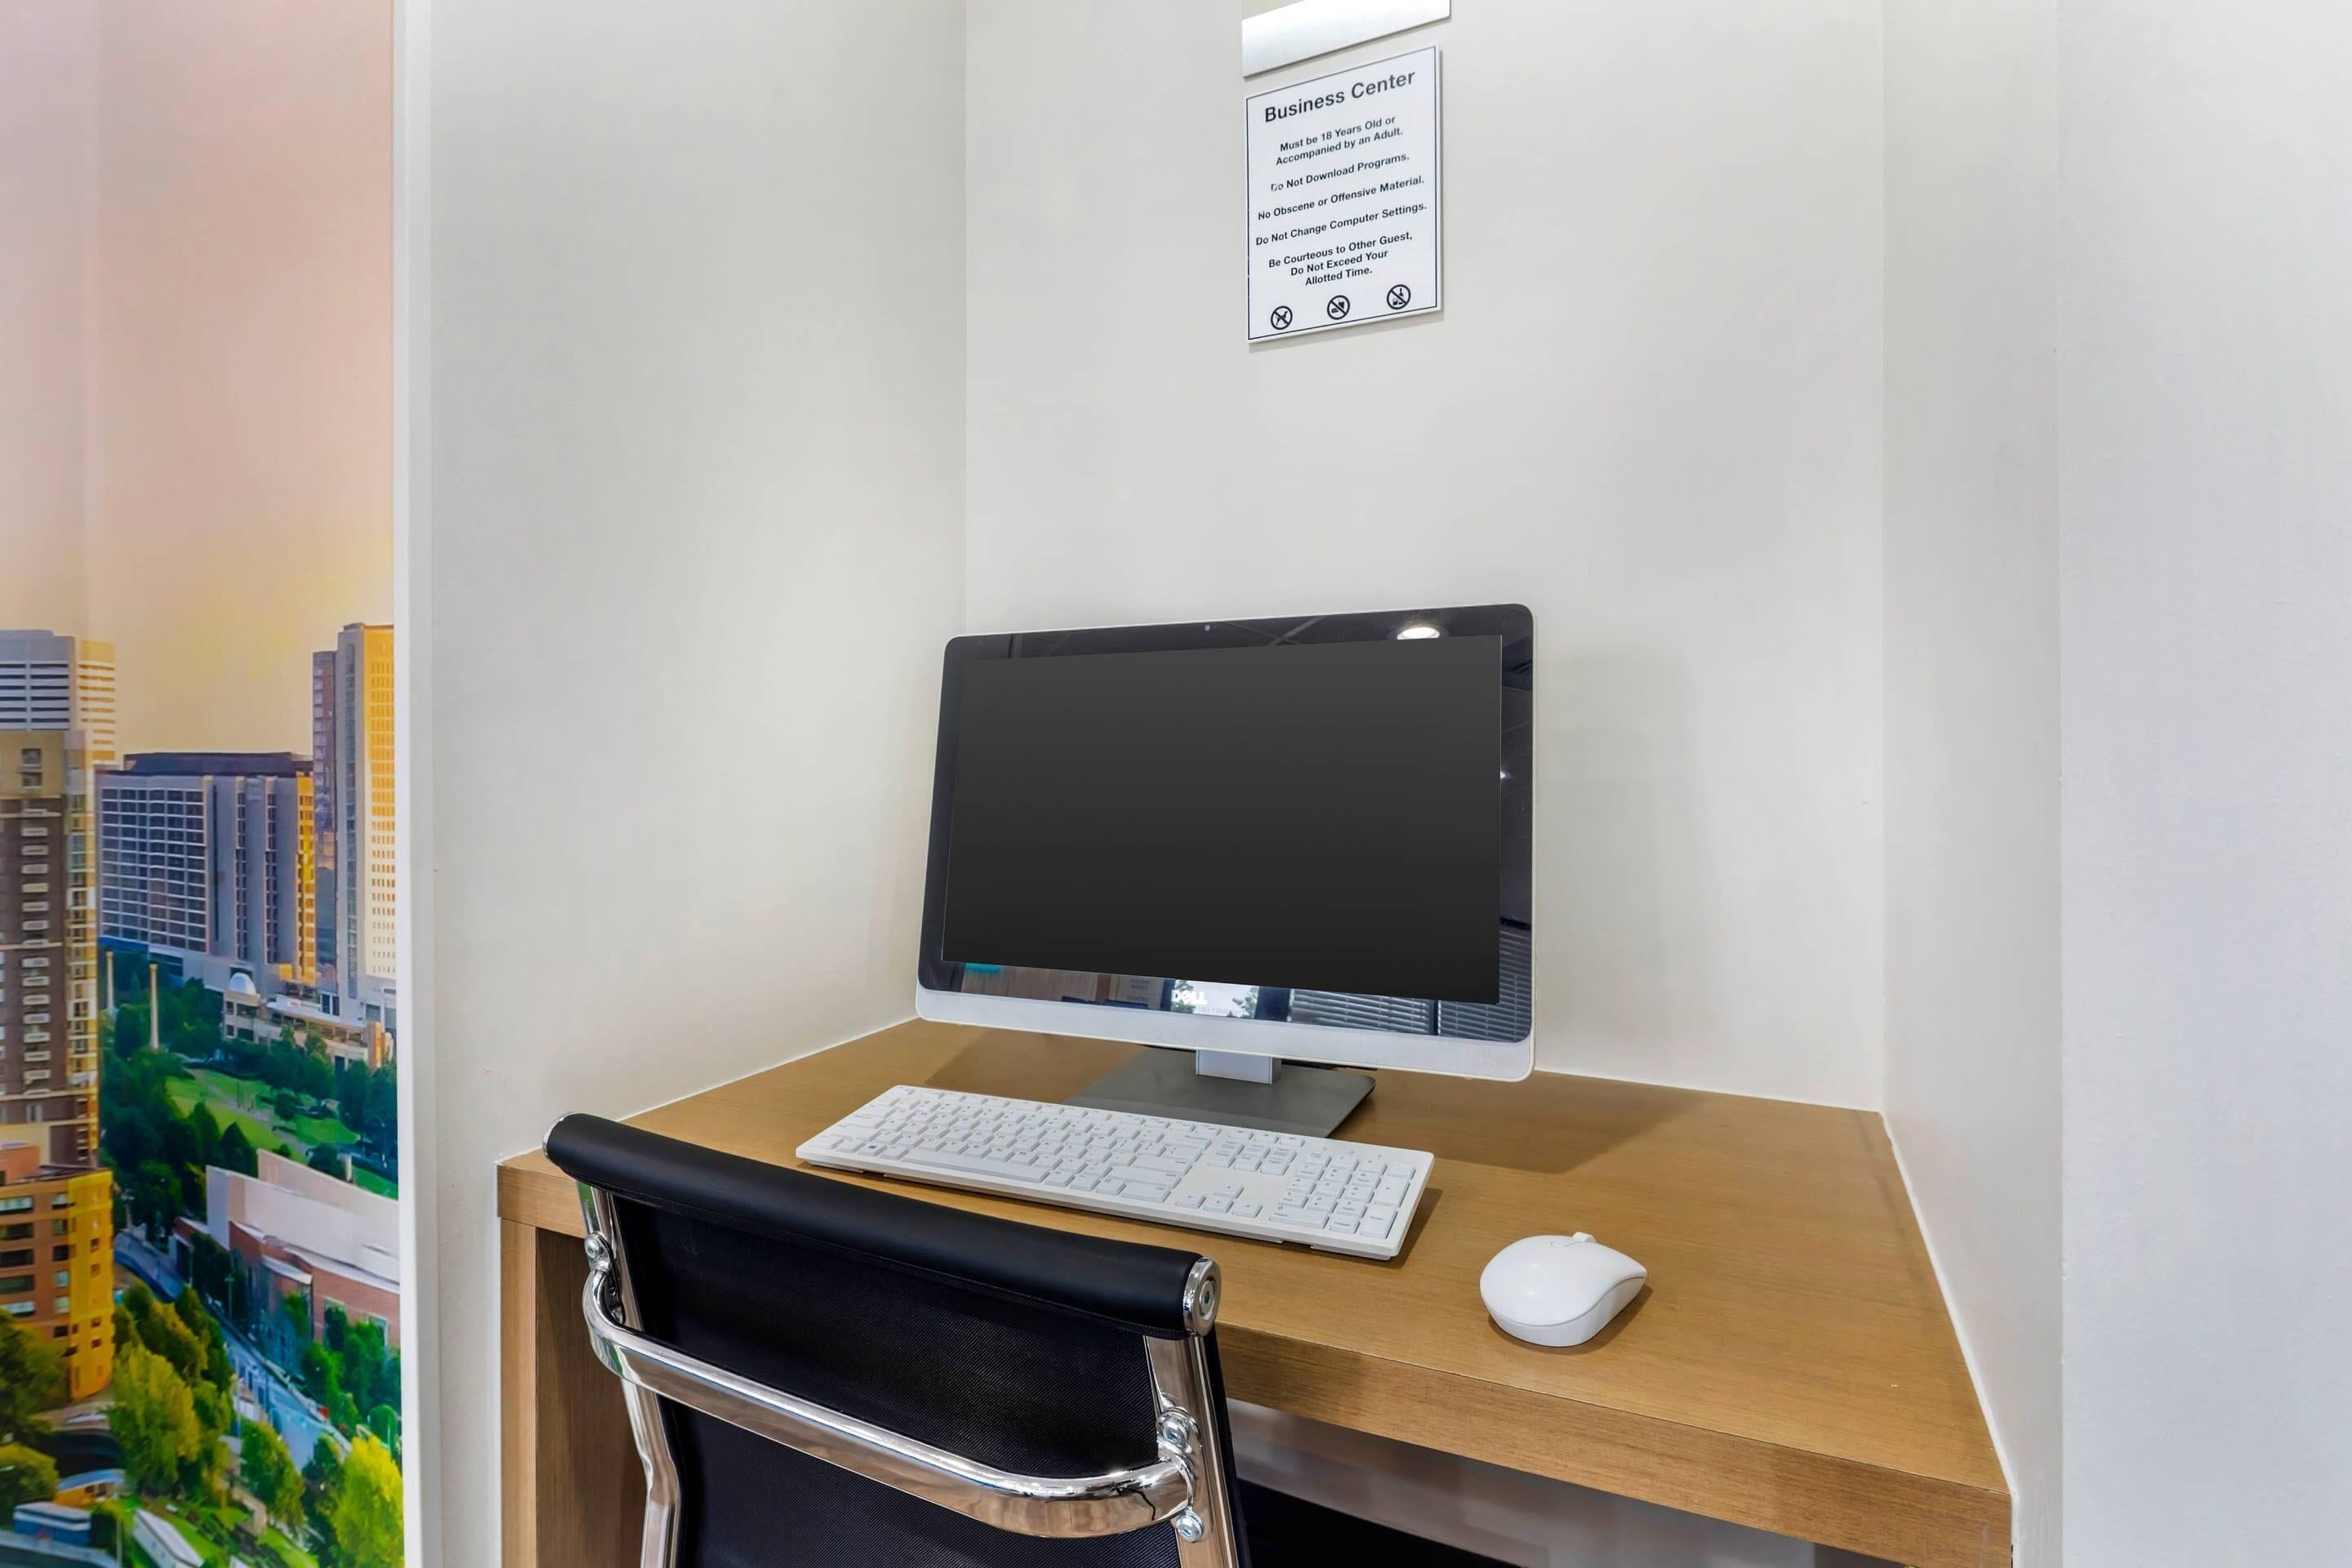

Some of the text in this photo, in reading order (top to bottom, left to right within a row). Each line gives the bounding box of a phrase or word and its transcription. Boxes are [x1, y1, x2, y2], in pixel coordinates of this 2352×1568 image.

[1265, 72, 1415, 122] Business Center
[1276, 127, 1402, 166] Accompanied by an Adult.
[1281, 139, 1303, 152] Must
[1306, 137, 1317, 145] be
[1321, 131, 1332, 140] 18
[1335, 126, 1361, 137] Years
[1365, 118, 1382, 130] Old
[1286, 177, 1303, 189] Not
[1306, 164, 1354, 184] Download
[1357, 154, 1410, 172] Programs.
[1258, 176, 1423, 220] No Obscene or Offensive Material.
[1256, 204, 1427, 246] Do Not Change Computer Settings.
[1269, 232, 1412, 268] Be Courteous to Other Guest,
[1291, 251, 1388, 276] Do Not Exceed Your
[1305, 268, 1372, 286] Allotted Time.
